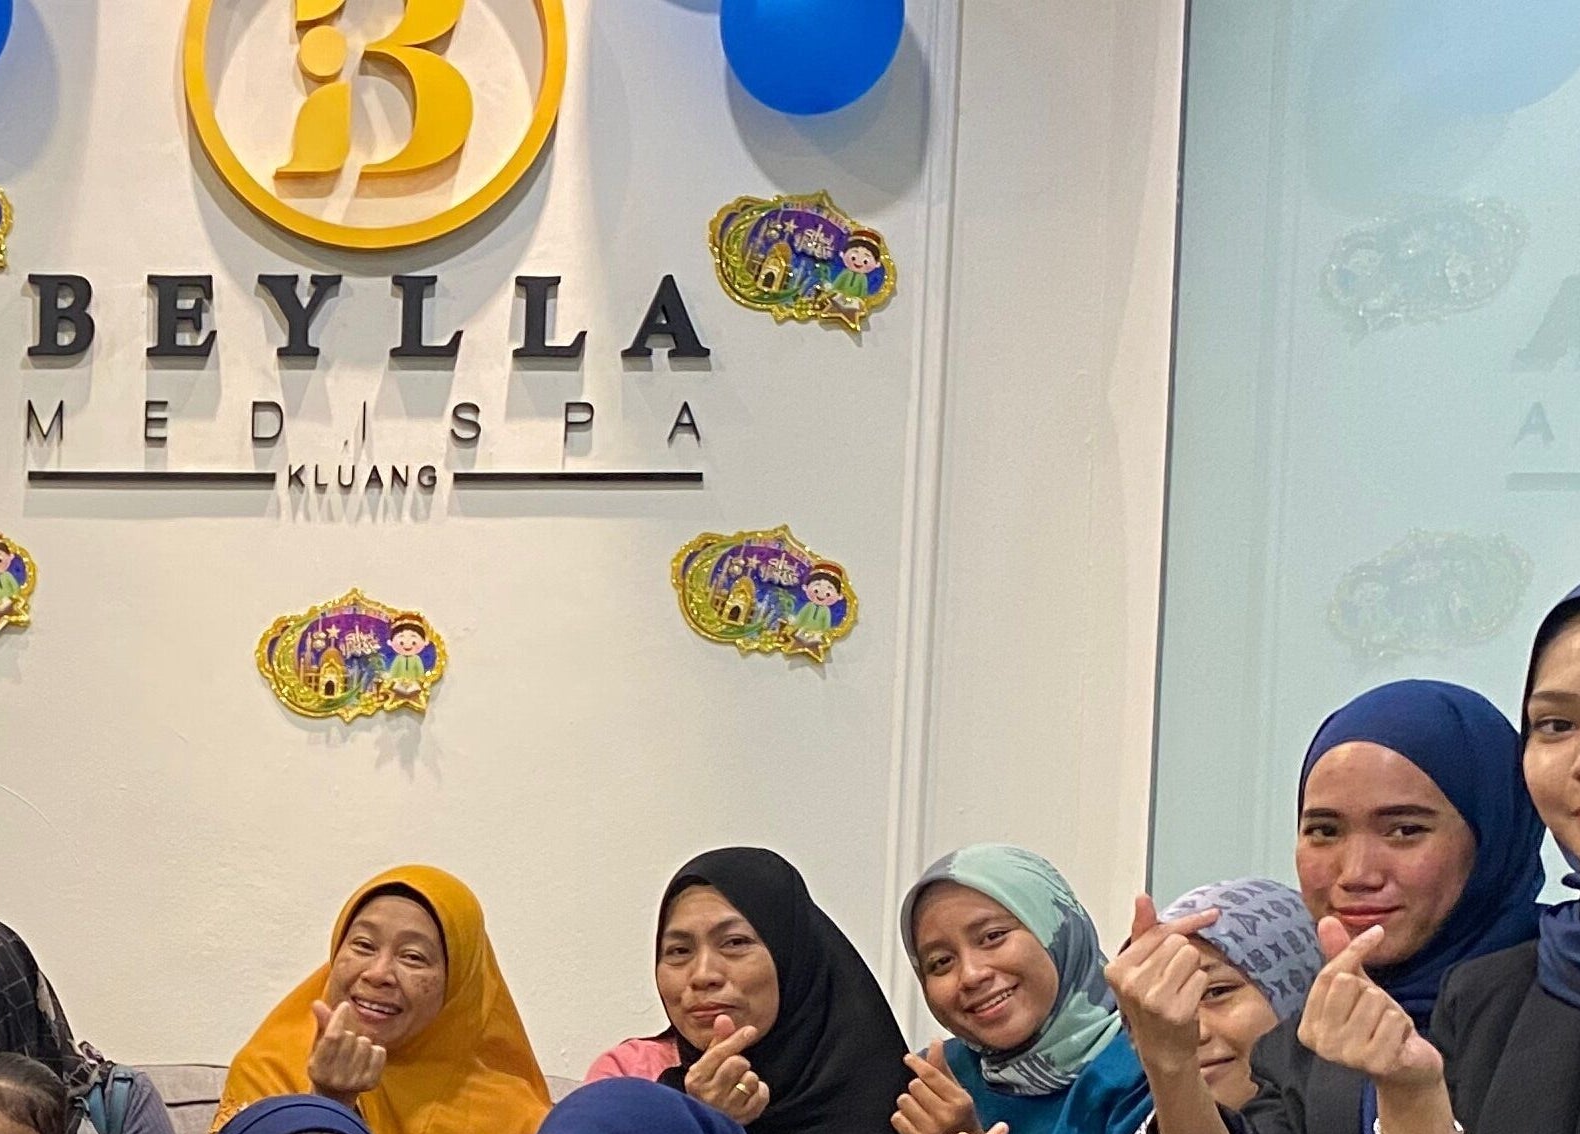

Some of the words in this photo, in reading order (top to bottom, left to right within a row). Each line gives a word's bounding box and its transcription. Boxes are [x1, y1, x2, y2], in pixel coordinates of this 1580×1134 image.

[28, 274, 710, 357] BEYLLA
[27, 399, 701, 446] MEDISPA
[288, 464, 437, 488] KLUANG
